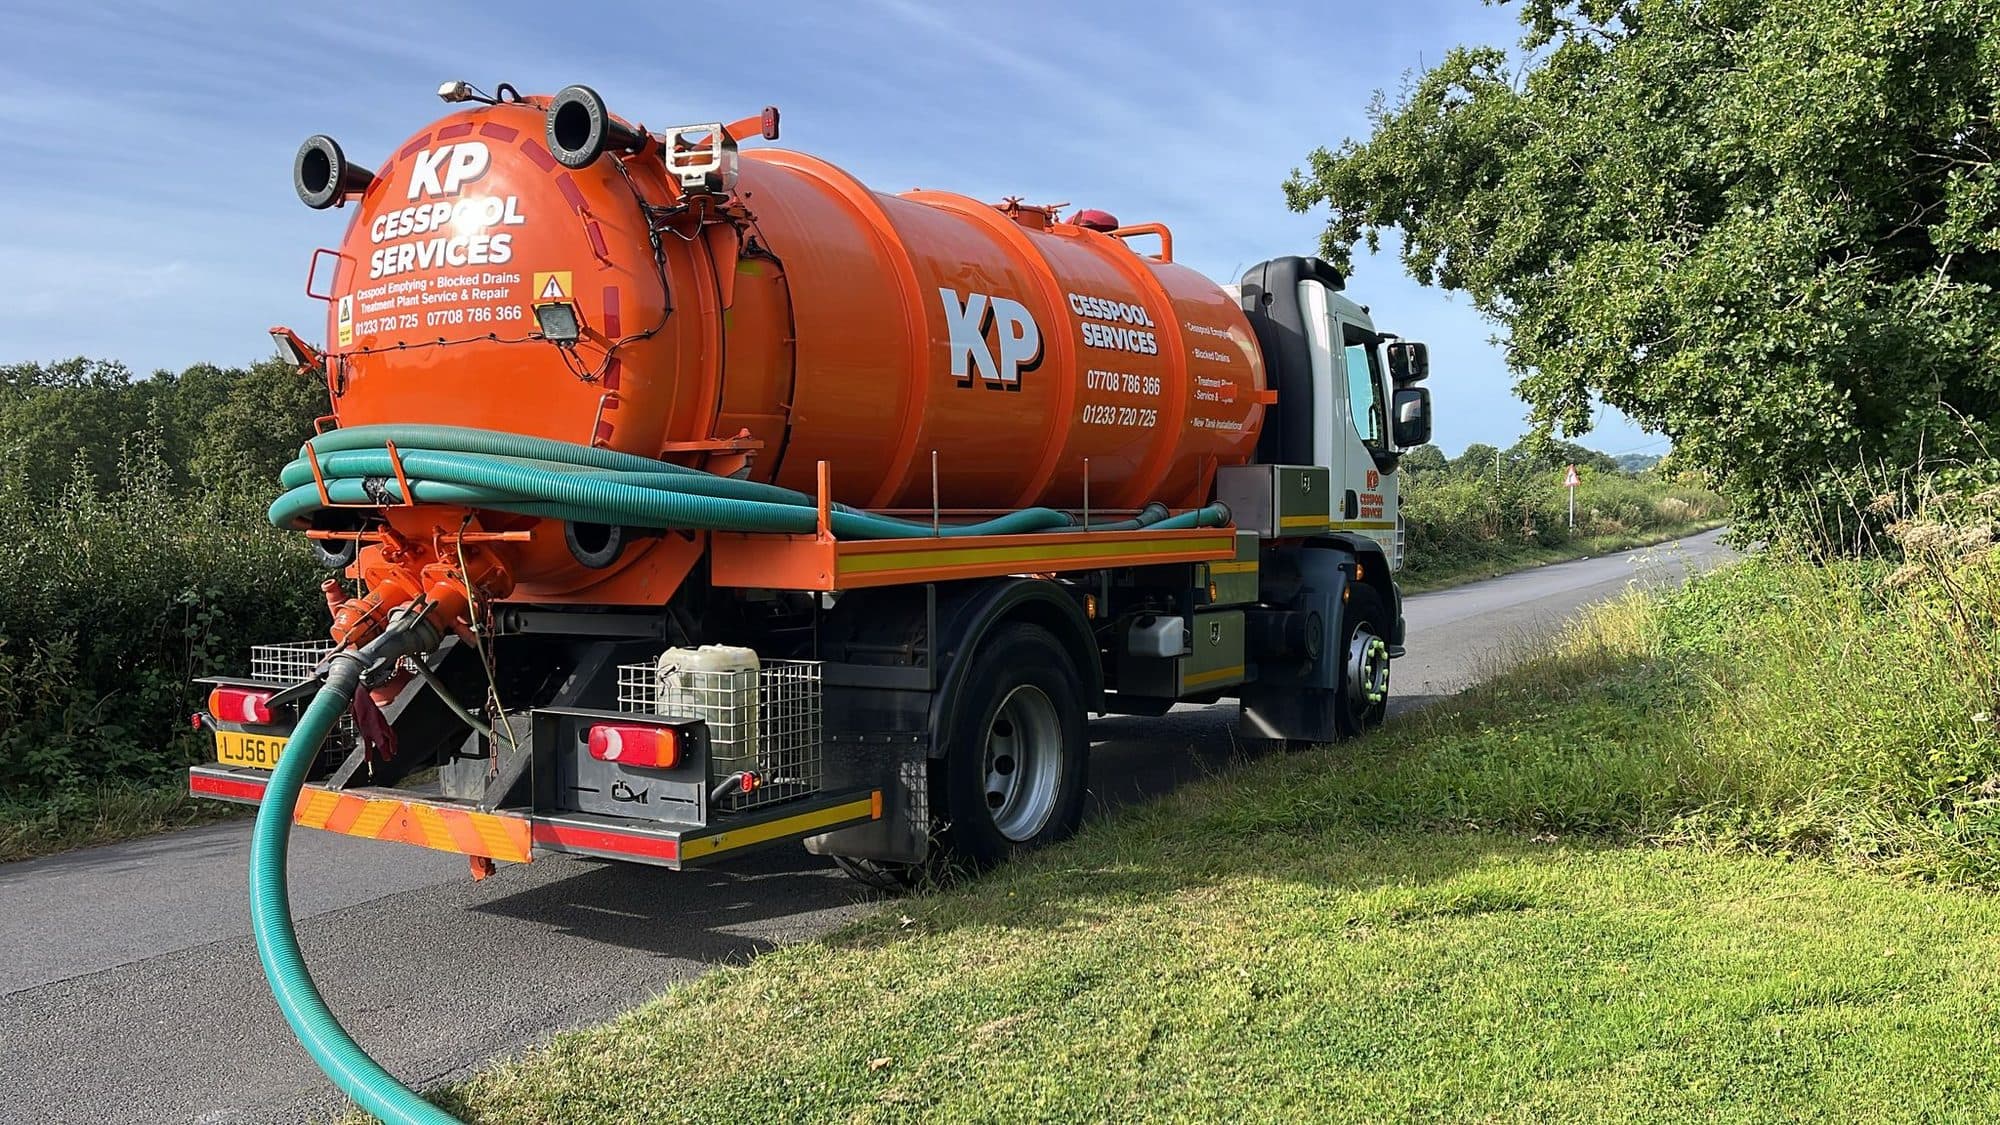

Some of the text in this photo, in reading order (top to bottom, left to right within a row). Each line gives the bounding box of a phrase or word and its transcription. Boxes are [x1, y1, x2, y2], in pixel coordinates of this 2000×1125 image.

[407, 142, 491, 201] KP
[370, 196, 525, 243] CESSPOOL
[369, 233, 512, 279] SERVICES
[357, 272, 521, 300] Cesspool Emptying Blocked Drains
[361, 287, 509, 314] Treatment Plant Service & Repair
[1068, 292, 1155, 327] CESSPOOL
[355, 319, 378, 336] 01233
[380, 316, 397, 331] 720
[399, 313, 418, 328] 725
[427, 309, 463, 326] 07708
[467, 307, 491, 322] 786
[495, 305, 522, 320] 366
[938, 287, 1043, 390] KP
[1081, 321, 1158, 355] SERVICES
[1195, 348, 1231, 363] Blocked Drains
[1087, 369, 1160, 395] 07708 786 366
[1196, 389, 1215, 401] Service
[1197, 375, 1221, 388] Treatment
[1083, 404, 1157, 427] 01233 720 725
[1367, 469, 1379, 491] KP
[223, 736, 266, 763] LJ56
